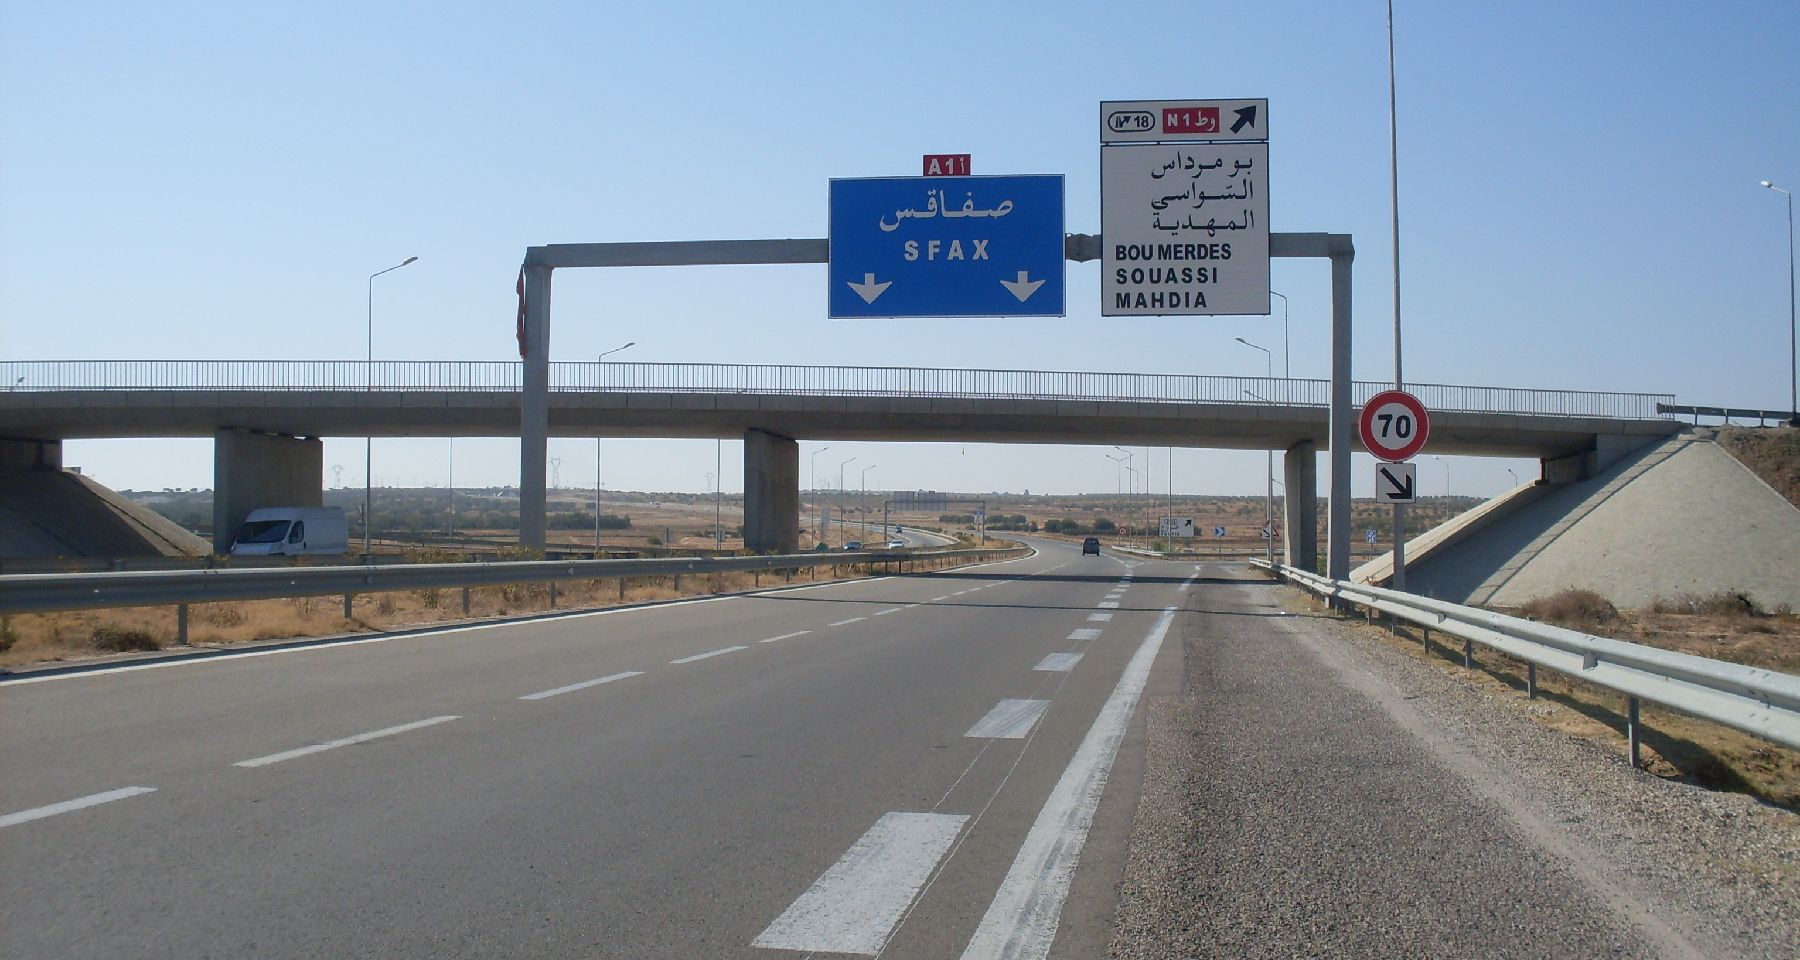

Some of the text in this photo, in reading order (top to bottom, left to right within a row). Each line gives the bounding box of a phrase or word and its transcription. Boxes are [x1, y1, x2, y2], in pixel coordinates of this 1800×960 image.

[1134, 115, 1149, 128] 18
[879, 188, 1013, 232] صفاقس
[1152, 209, 1255, 237] المهدية
[904, 239, 989, 261] SFAX
[1115, 243, 1232, 261] BOU MERDES
[1116, 267, 1218, 285] SOUASSI
[1116, 291, 1207, 309] MAHDIA
[1377, 413, 1411, 438] 70
